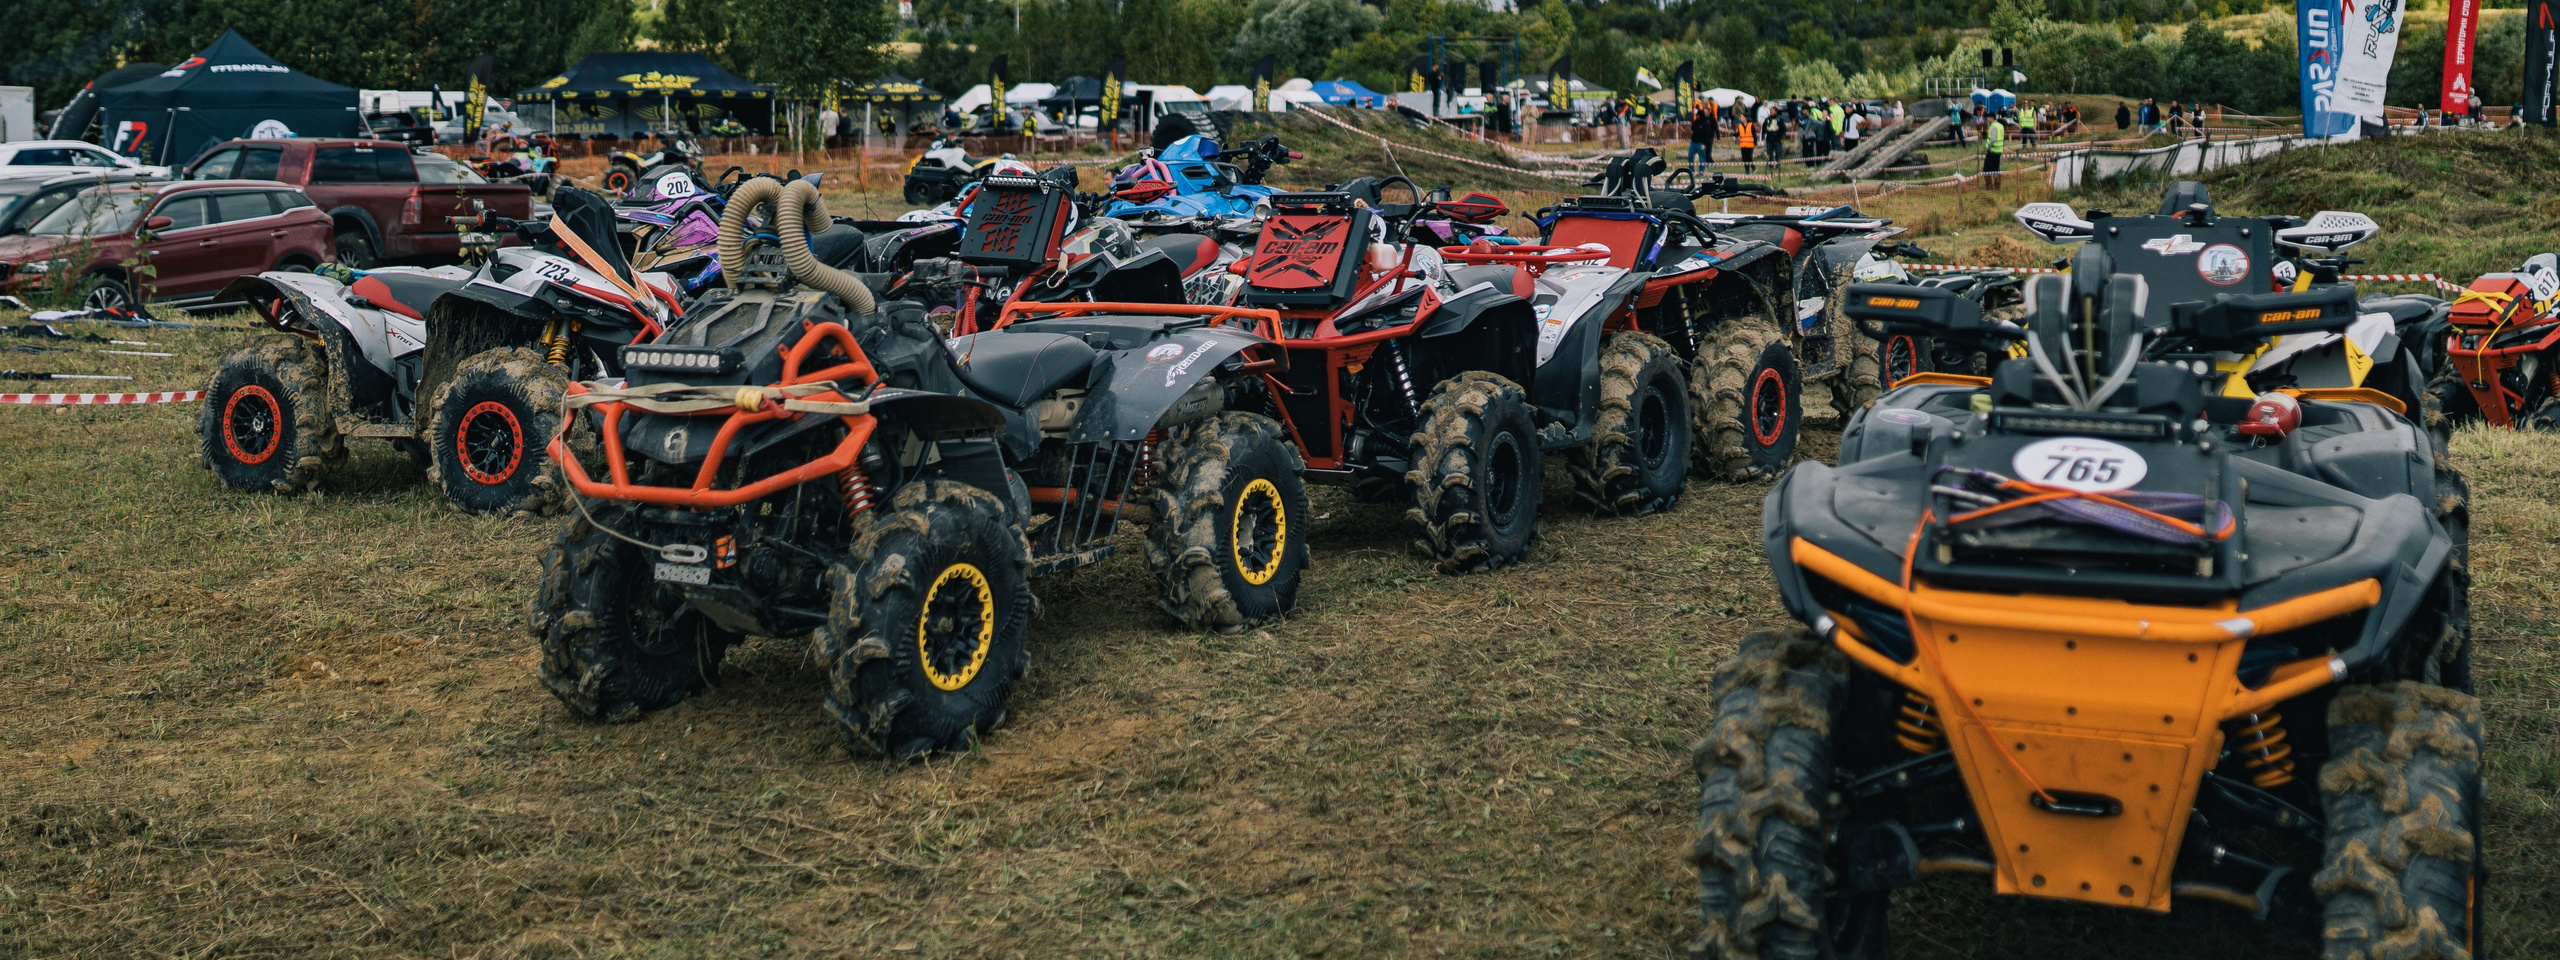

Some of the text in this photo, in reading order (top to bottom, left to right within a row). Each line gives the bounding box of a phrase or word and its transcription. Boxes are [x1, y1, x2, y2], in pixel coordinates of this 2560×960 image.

[2456, 17, 2468, 65] ТЕРРИТОРИЯ
[211, 63, 290, 74] F7TRAVEL.RU
[2308, 8, 2334, 112] PARSUN
[2541, 29, 2555, 121] FORMULA
[113, 121, 147, 152] F7
[667, 180, 690, 196] 202
[2032, 220, 2075, 235] can-am
[1262, 241, 1339, 255] can-am
[2305, 233, 2353, 244] can-am
[535, 260, 570, 281] 723
[2538, 271, 2556, 297] 617
[1868, 296, 1920, 310] can-am
[2260, 308, 2321, 324] can-am
[1179, 340, 1218, 370] can-am
[2042, 455, 2125, 484] 765
